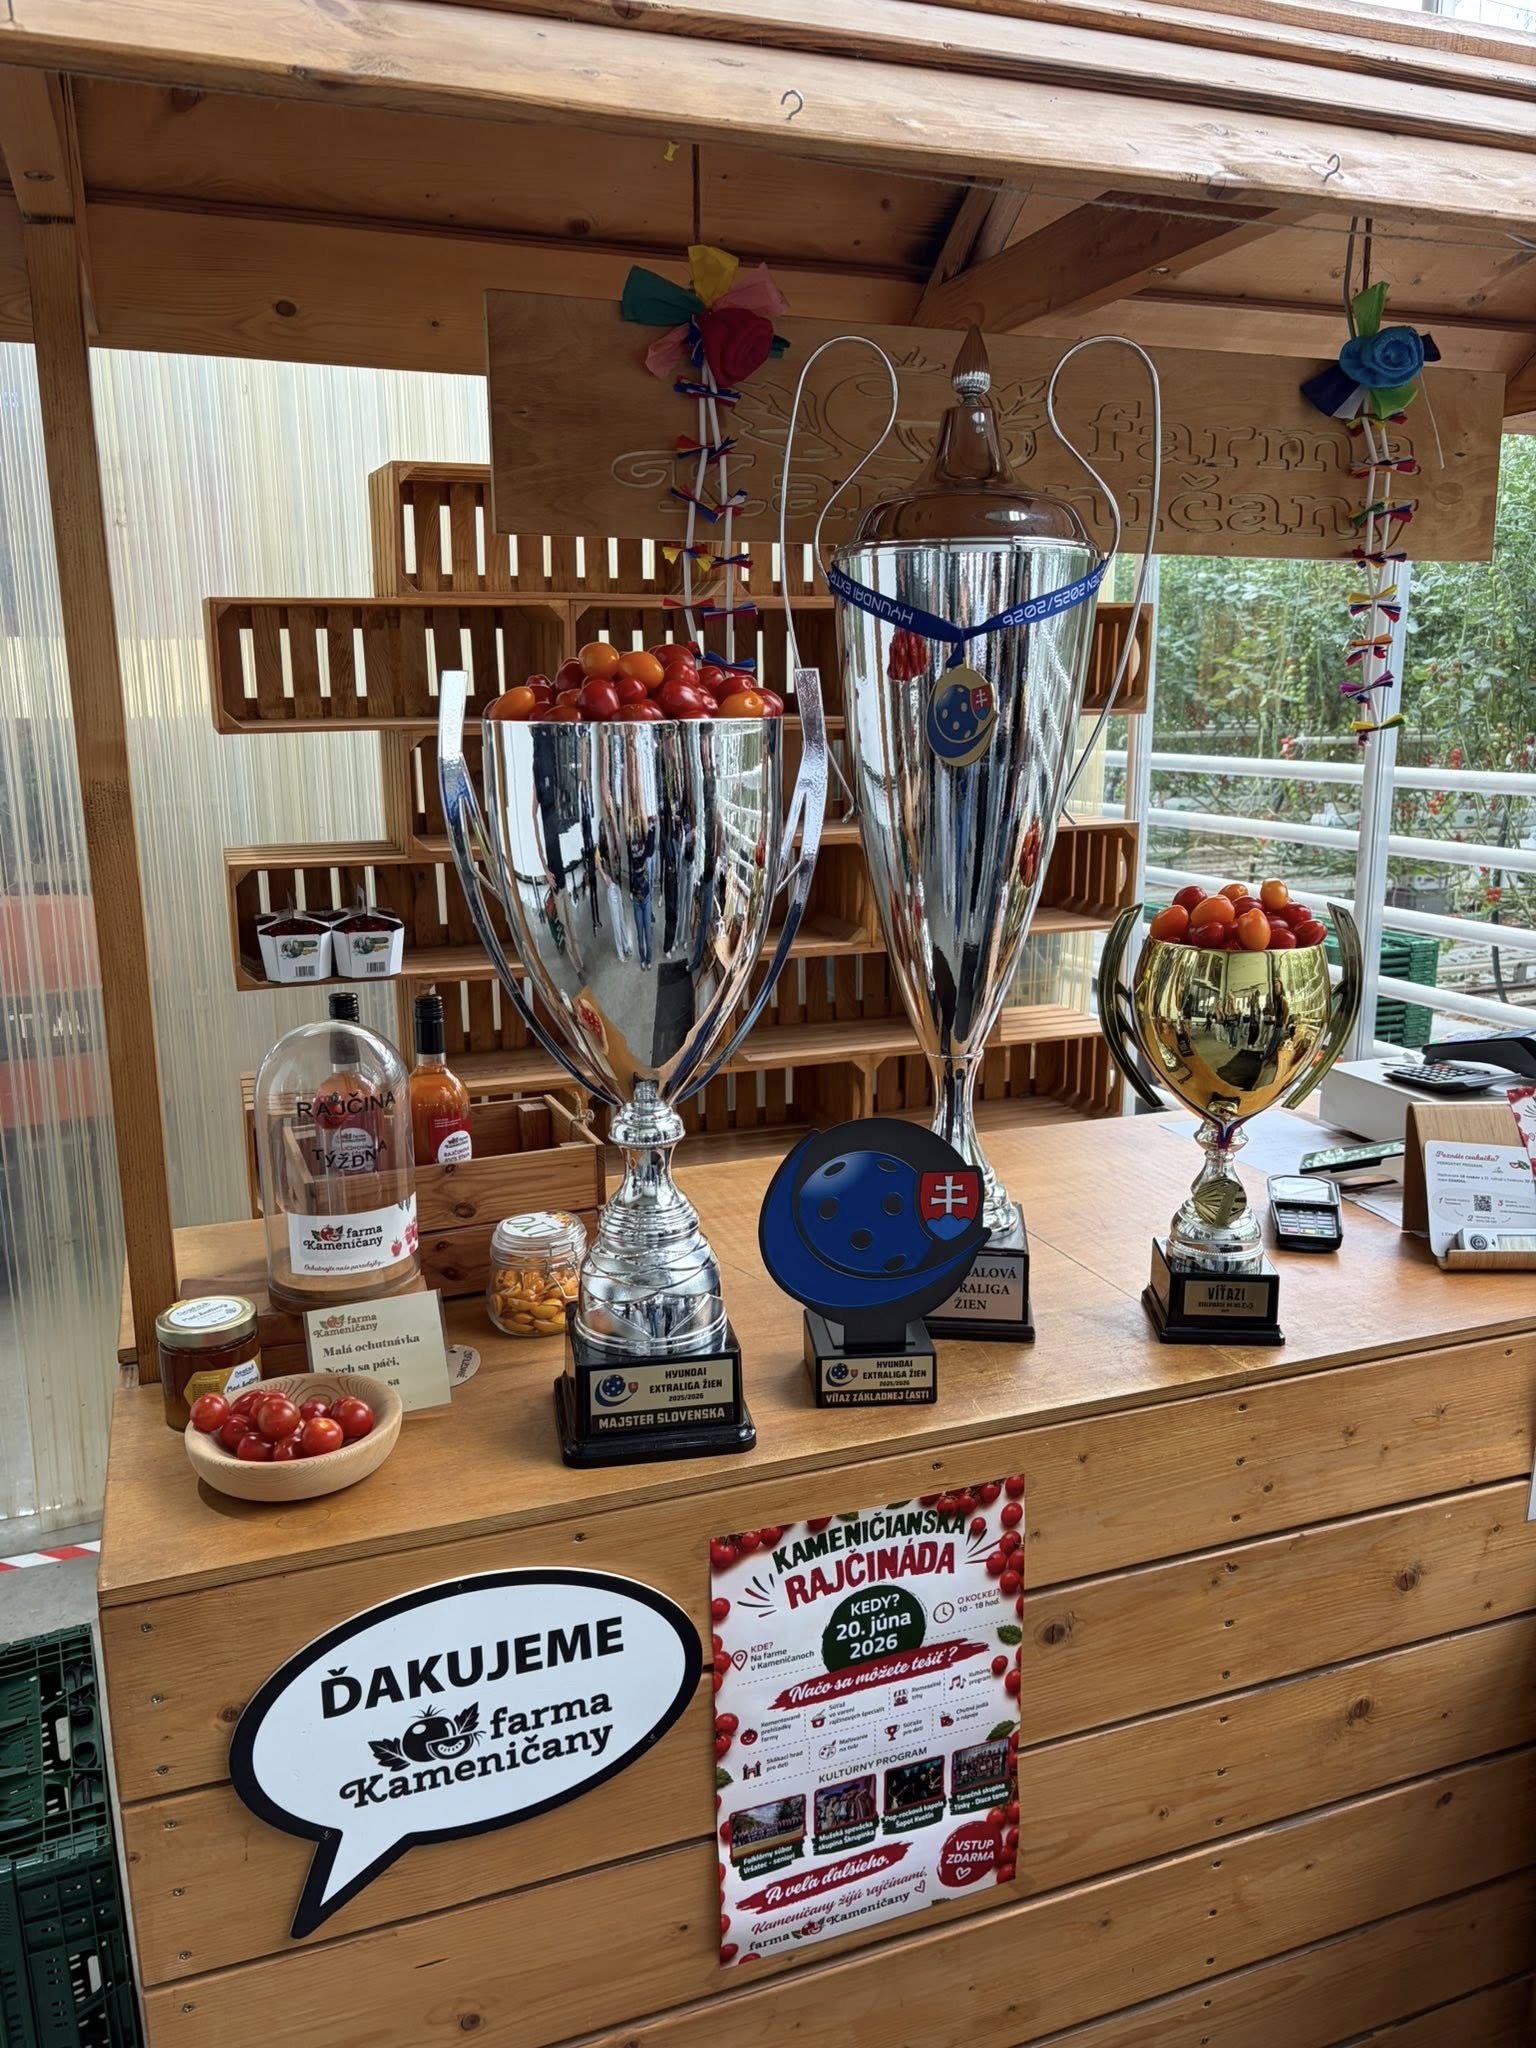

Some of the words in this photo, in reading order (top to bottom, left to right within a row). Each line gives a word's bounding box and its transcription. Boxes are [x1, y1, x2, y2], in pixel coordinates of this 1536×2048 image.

[1088, 401, 1421, 476] farma
[612, 449, 1420, 548] Kaničany
[853, 585, 914, 625] HYUNDAI
[1002, 582, 1085, 626] 2025/2026
[296, 1091, 396, 1118] RAJČINA
[312, 1140, 388, 1169] TÝŽDŇA
[346, 1225, 383, 1238] farma
[303, 1236, 383, 1251] Kameničany
[966, 1266, 1017, 1280] ALOVÁ
[959, 1282, 1010, 1295] RALIGA
[954, 1297, 987, 1310] ŽIEN
[347, 1313, 377, 1325] farma
[313, 1322, 378, 1338] Kameničany
[323, 1343, 353, 1358] Malá
[355, 1334, 420, 1351] ochutnávka
[357, 1363, 370, 1371] sa
[876, 1360, 913, 1369] HYUNDAI
[665, 1367, 707, 1379] HYUNDAI
[862, 1371, 906, 1380] EXTRALIGA
[909, 1369, 927, 1378] ŽIEN
[387, 1378, 400, 1386] sa
[649, 1381, 700, 1394] EXTRALIGA
[702, 1379, 722, 1389] ŽIEN
[668, 1392, 704, 1402] 2025/2026
[853, 1391, 904, 1402] ZÁKLADNEJ
[905, 1390, 929, 1399] ČASTI
[599, 1414, 655, 1430] MAJSTER
[656, 1407, 725, 1424] SLOVENSKA
[772, 1510, 965, 1574] KAMENIČIANSKA
[784, 1538, 955, 1609] RAJČINÁDA
[957, 1596, 964, 1604] O
[965, 1588, 1000, 1603] KOĽKEJ?
[851, 1594, 899, 1616] KEDY?
[959, 1605, 967, 1613] 10
[975, 1601, 983, 1610] 18
[984, 1598, 1000, 1608] hod.
[836, 1620, 865, 1641] 20.
[869, 1612, 912, 1637] júna
[750, 1642, 774, 1654] KDE?
[849, 1633, 898, 1659] 2026
[750, 1653, 763, 1662] Na
[763, 1649, 787, 1661] farme
[751, 1663, 757, 1671] v
[757, 1650, 815, 1670] Kameničanoch
[321, 1616, 624, 1719] ĎAKUJEME
[834, 1677, 853, 1691] sa
[855, 1662, 909, 1685] môžete
[490, 1692, 612, 1740] farma
[837, 1707, 855, 1717] varení
[790, 1750, 803, 1758] hrad
[339, 1723, 613, 1808] Kameničany
[777, 1761, 789, 1770] deti
[818, 1760, 875, 1783] KULTÚRNY
[876, 1747, 927, 1767] PROGRAM
[982, 1783, 1005, 1795] skupina
[923, 1800, 944, 1813] kapela
[818, 1839, 843, 1851] skupina
[955, 1839, 994, 1851] VSTUP
[743, 1850, 773, 1866] Folklórny
[774, 1845, 793, 1857] súbor
[773, 1853, 795, 1865] seniori
[946, 1851, 994, 1864] ZDARMA
[766, 1886, 783, 1904] A
[785, 1875, 820, 1898] veľa
[822, 1855, 890, 1884] ďalšieho.
[752, 1901, 836, 1936] Kameničany
[838, 1889, 864, 1908] žijú
[866, 1866, 928, 1897] rajčinami.
[750, 1931, 790, 1950] farma
[824, 1892, 910, 1925] Kameničany
